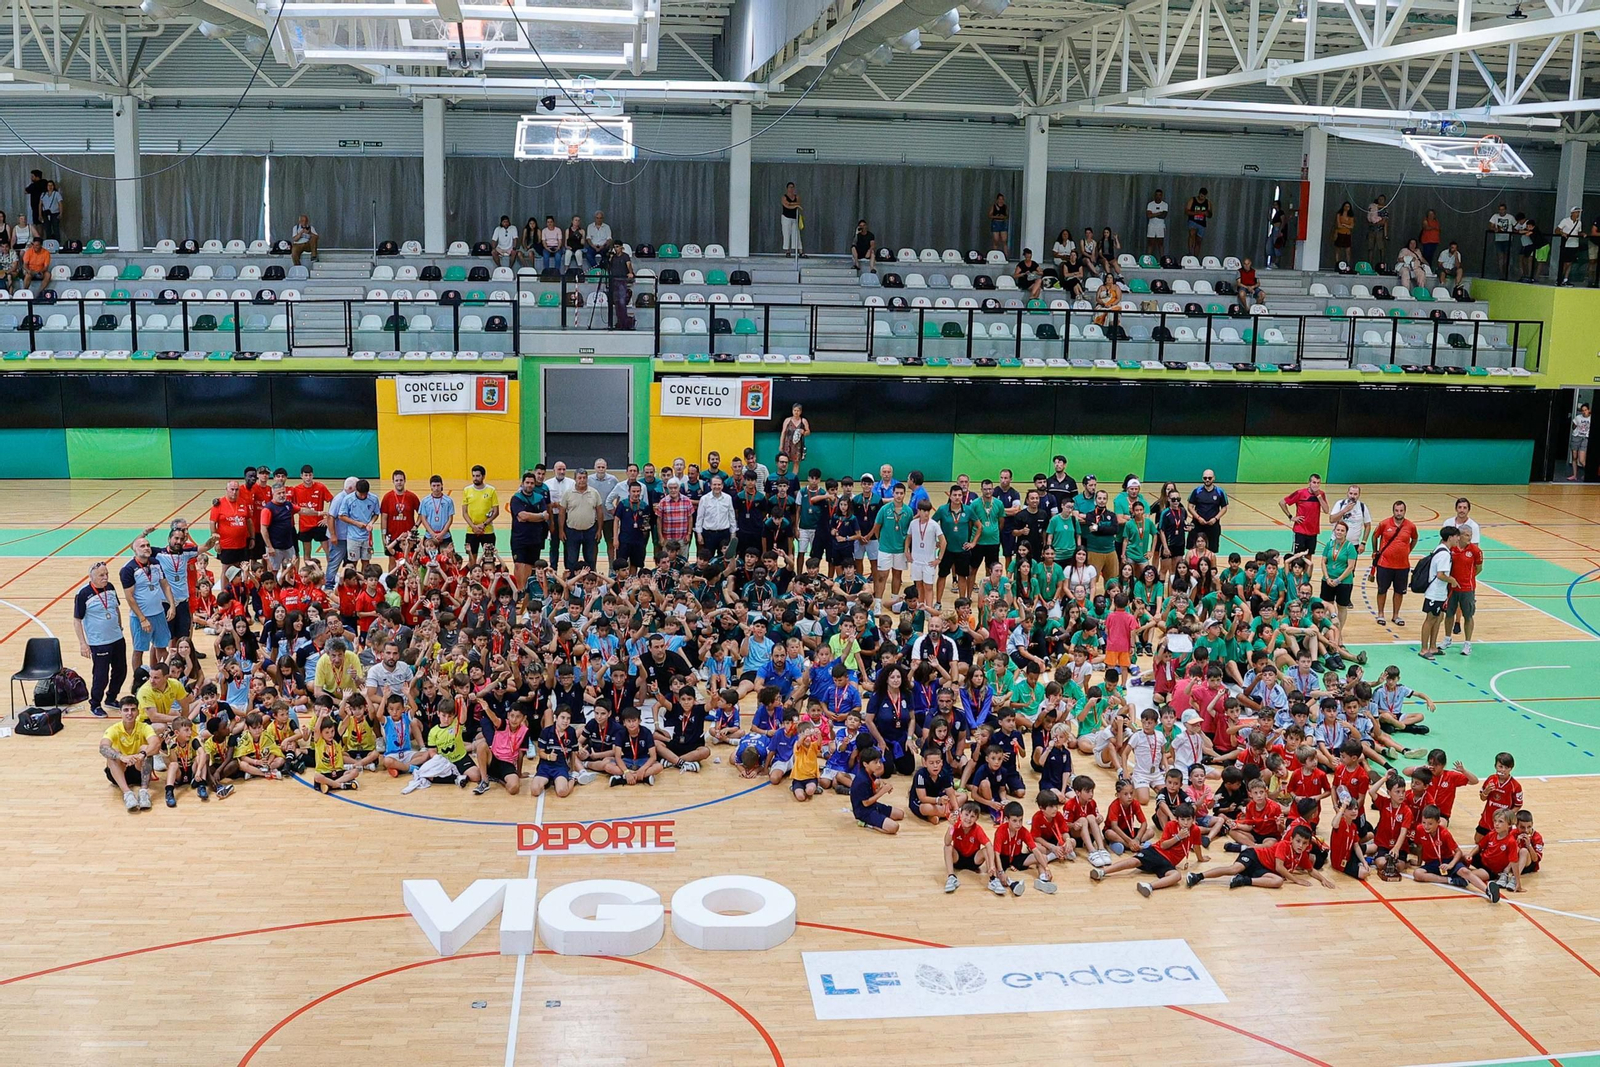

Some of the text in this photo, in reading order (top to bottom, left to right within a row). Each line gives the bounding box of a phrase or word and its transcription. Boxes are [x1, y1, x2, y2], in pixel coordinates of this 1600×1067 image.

[404, 382, 465, 393] CONCELLO
[669, 385, 730, 396] CONCELLO
[413, 392, 459, 404] DE VIGO
[676, 396, 722, 407] DE VIGO
[517, 820, 676, 850] DEPORTE
[402, 875, 796, 956] VIGO
[820, 964, 1201, 996] LF endesa
